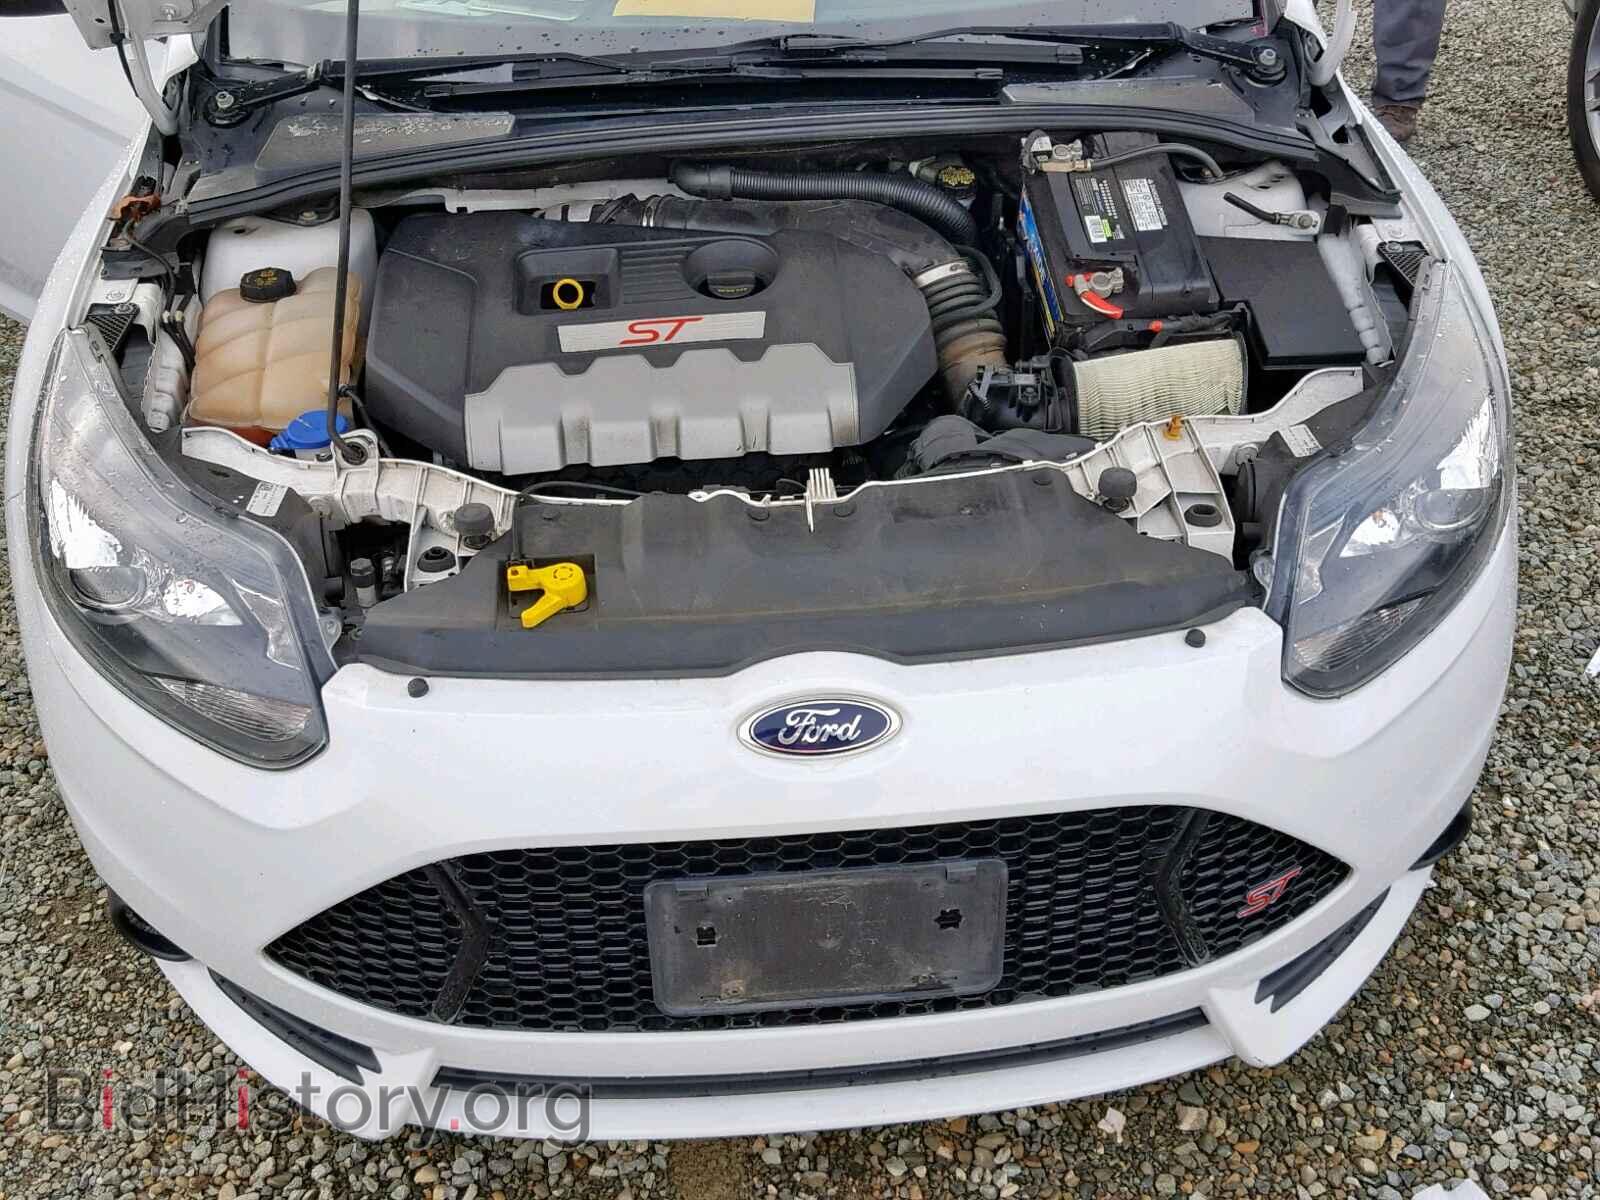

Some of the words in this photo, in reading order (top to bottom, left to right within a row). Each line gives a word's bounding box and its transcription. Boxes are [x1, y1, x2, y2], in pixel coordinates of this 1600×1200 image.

[620, 317, 704, 344] ST
[777, 708, 862, 744] Ford
[1236, 866, 1302, 919] ST
